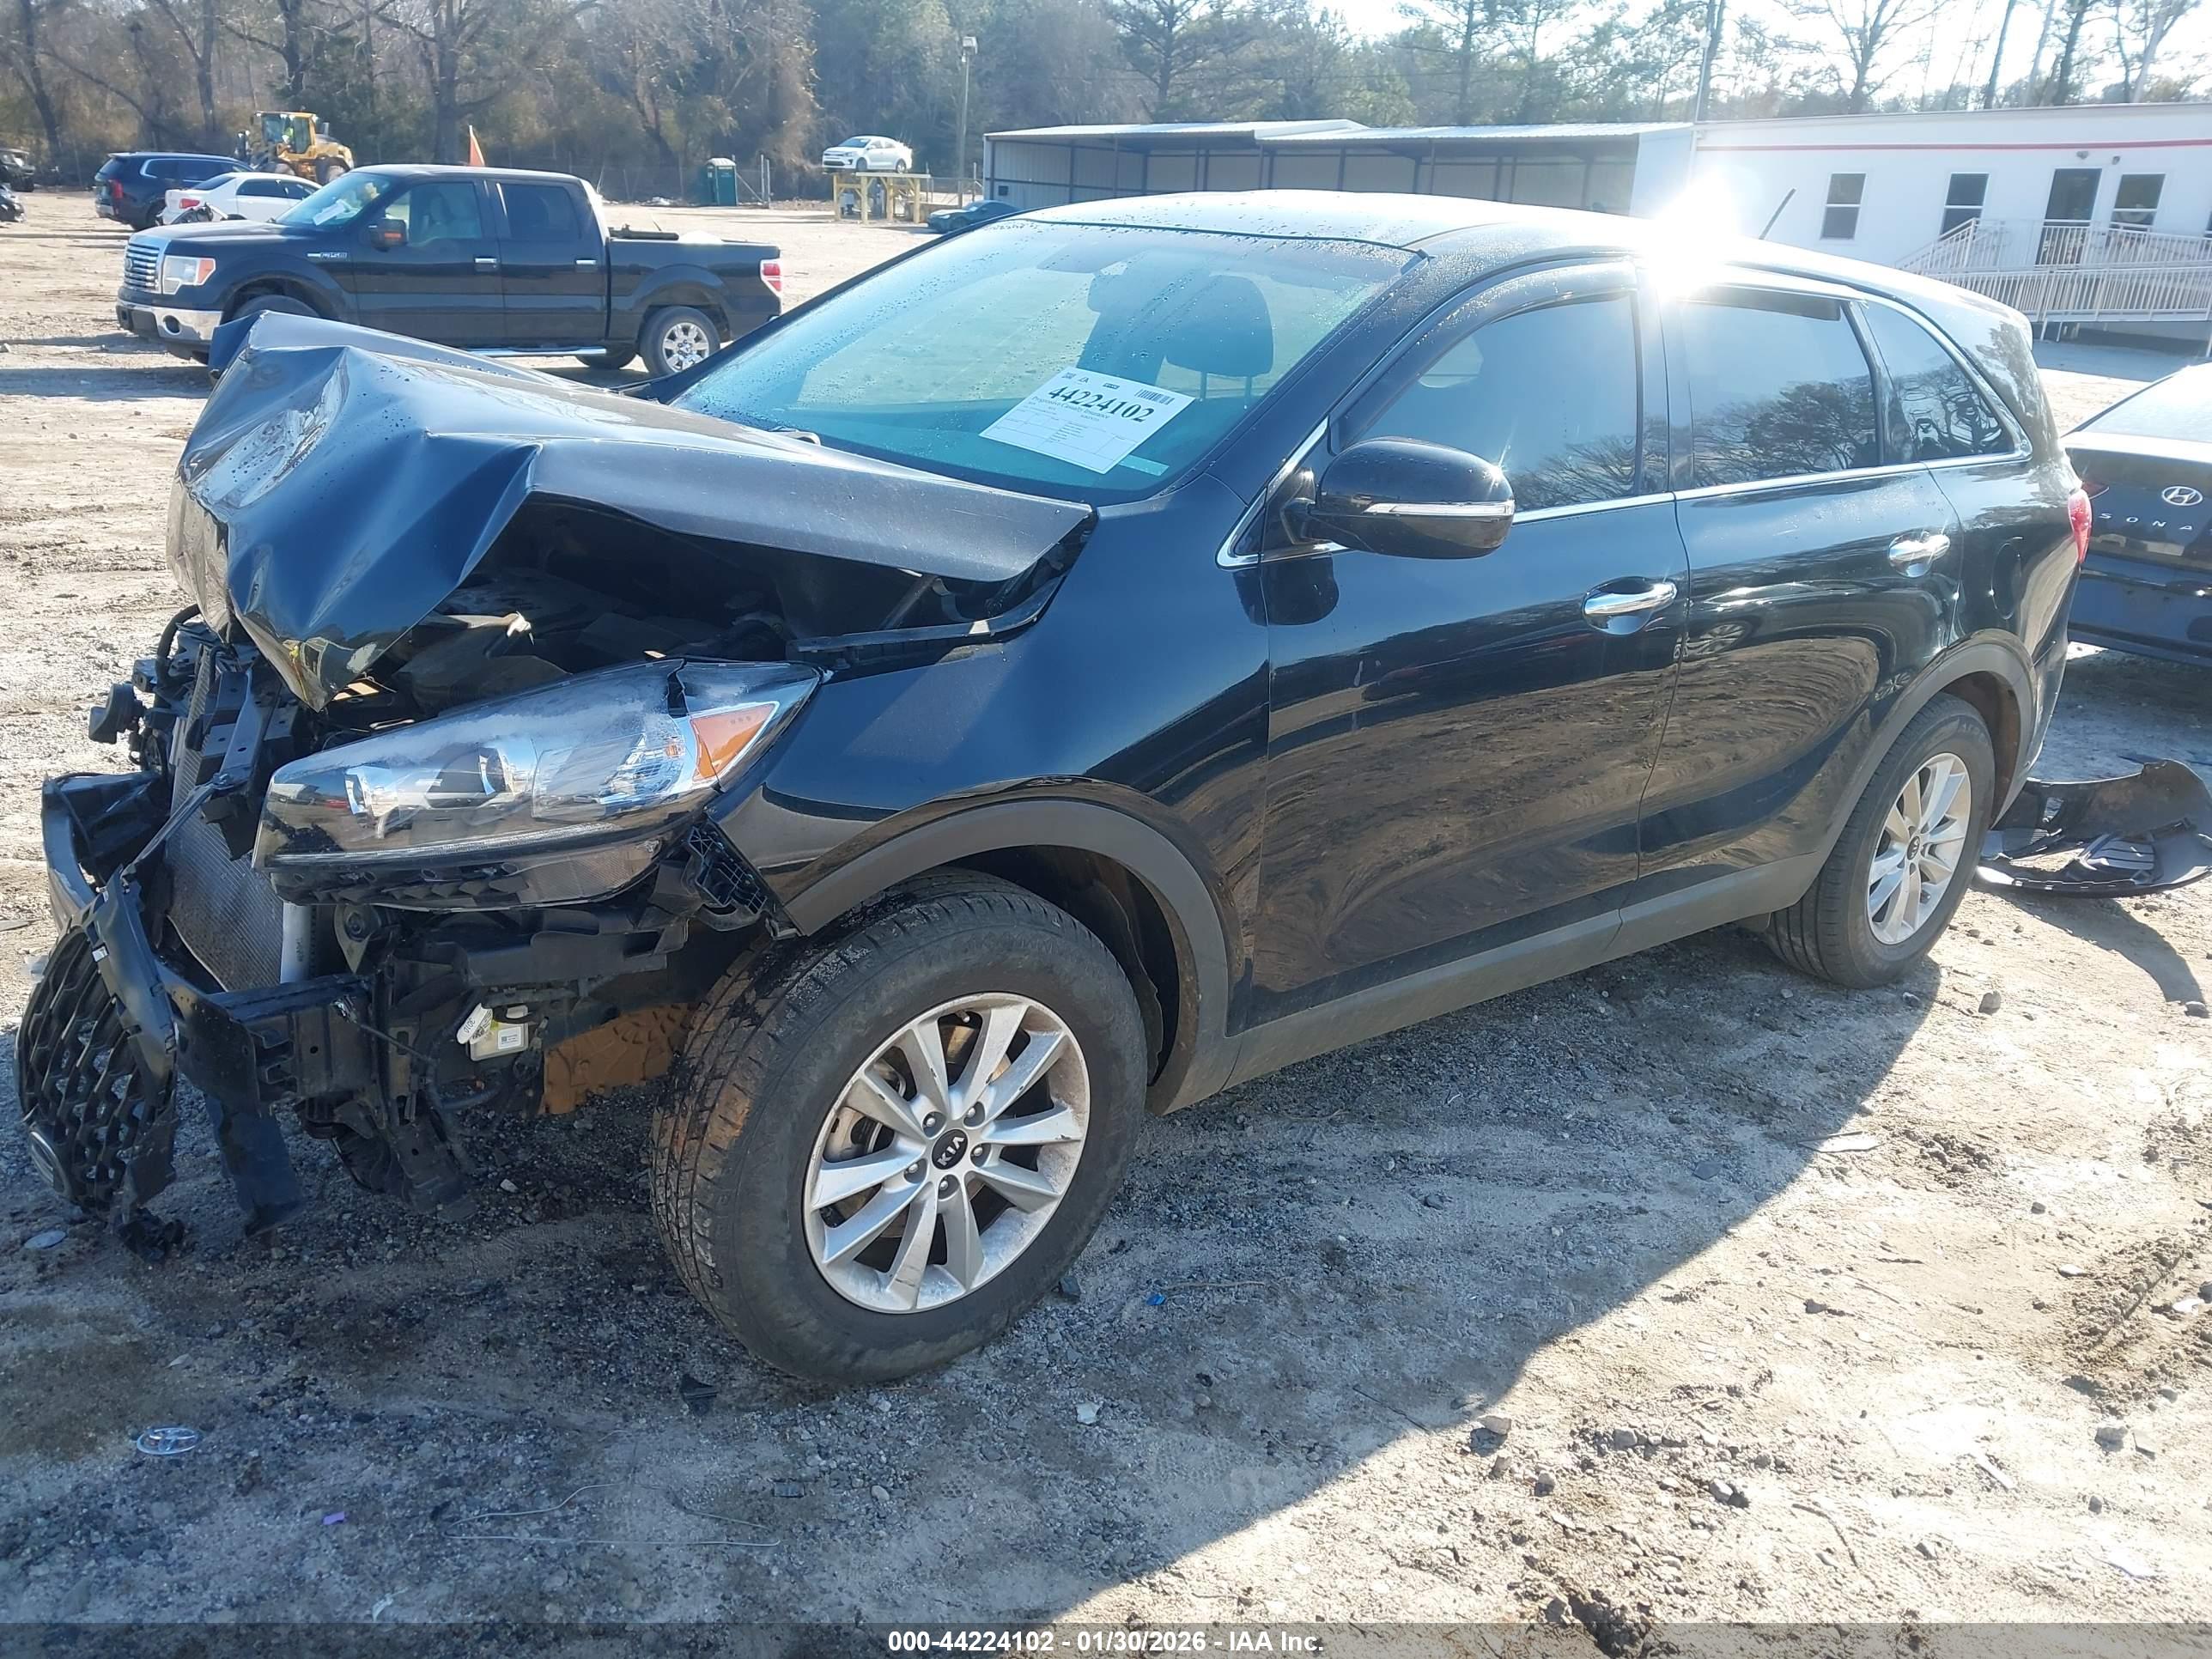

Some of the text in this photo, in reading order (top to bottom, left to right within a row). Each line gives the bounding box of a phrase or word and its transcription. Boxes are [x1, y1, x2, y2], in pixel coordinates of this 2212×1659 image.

[1048, 386, 1155, 422] 44224102
[2099, 513, 2212, 536] SONA
[937, 1136, 964, 1166] KIA
